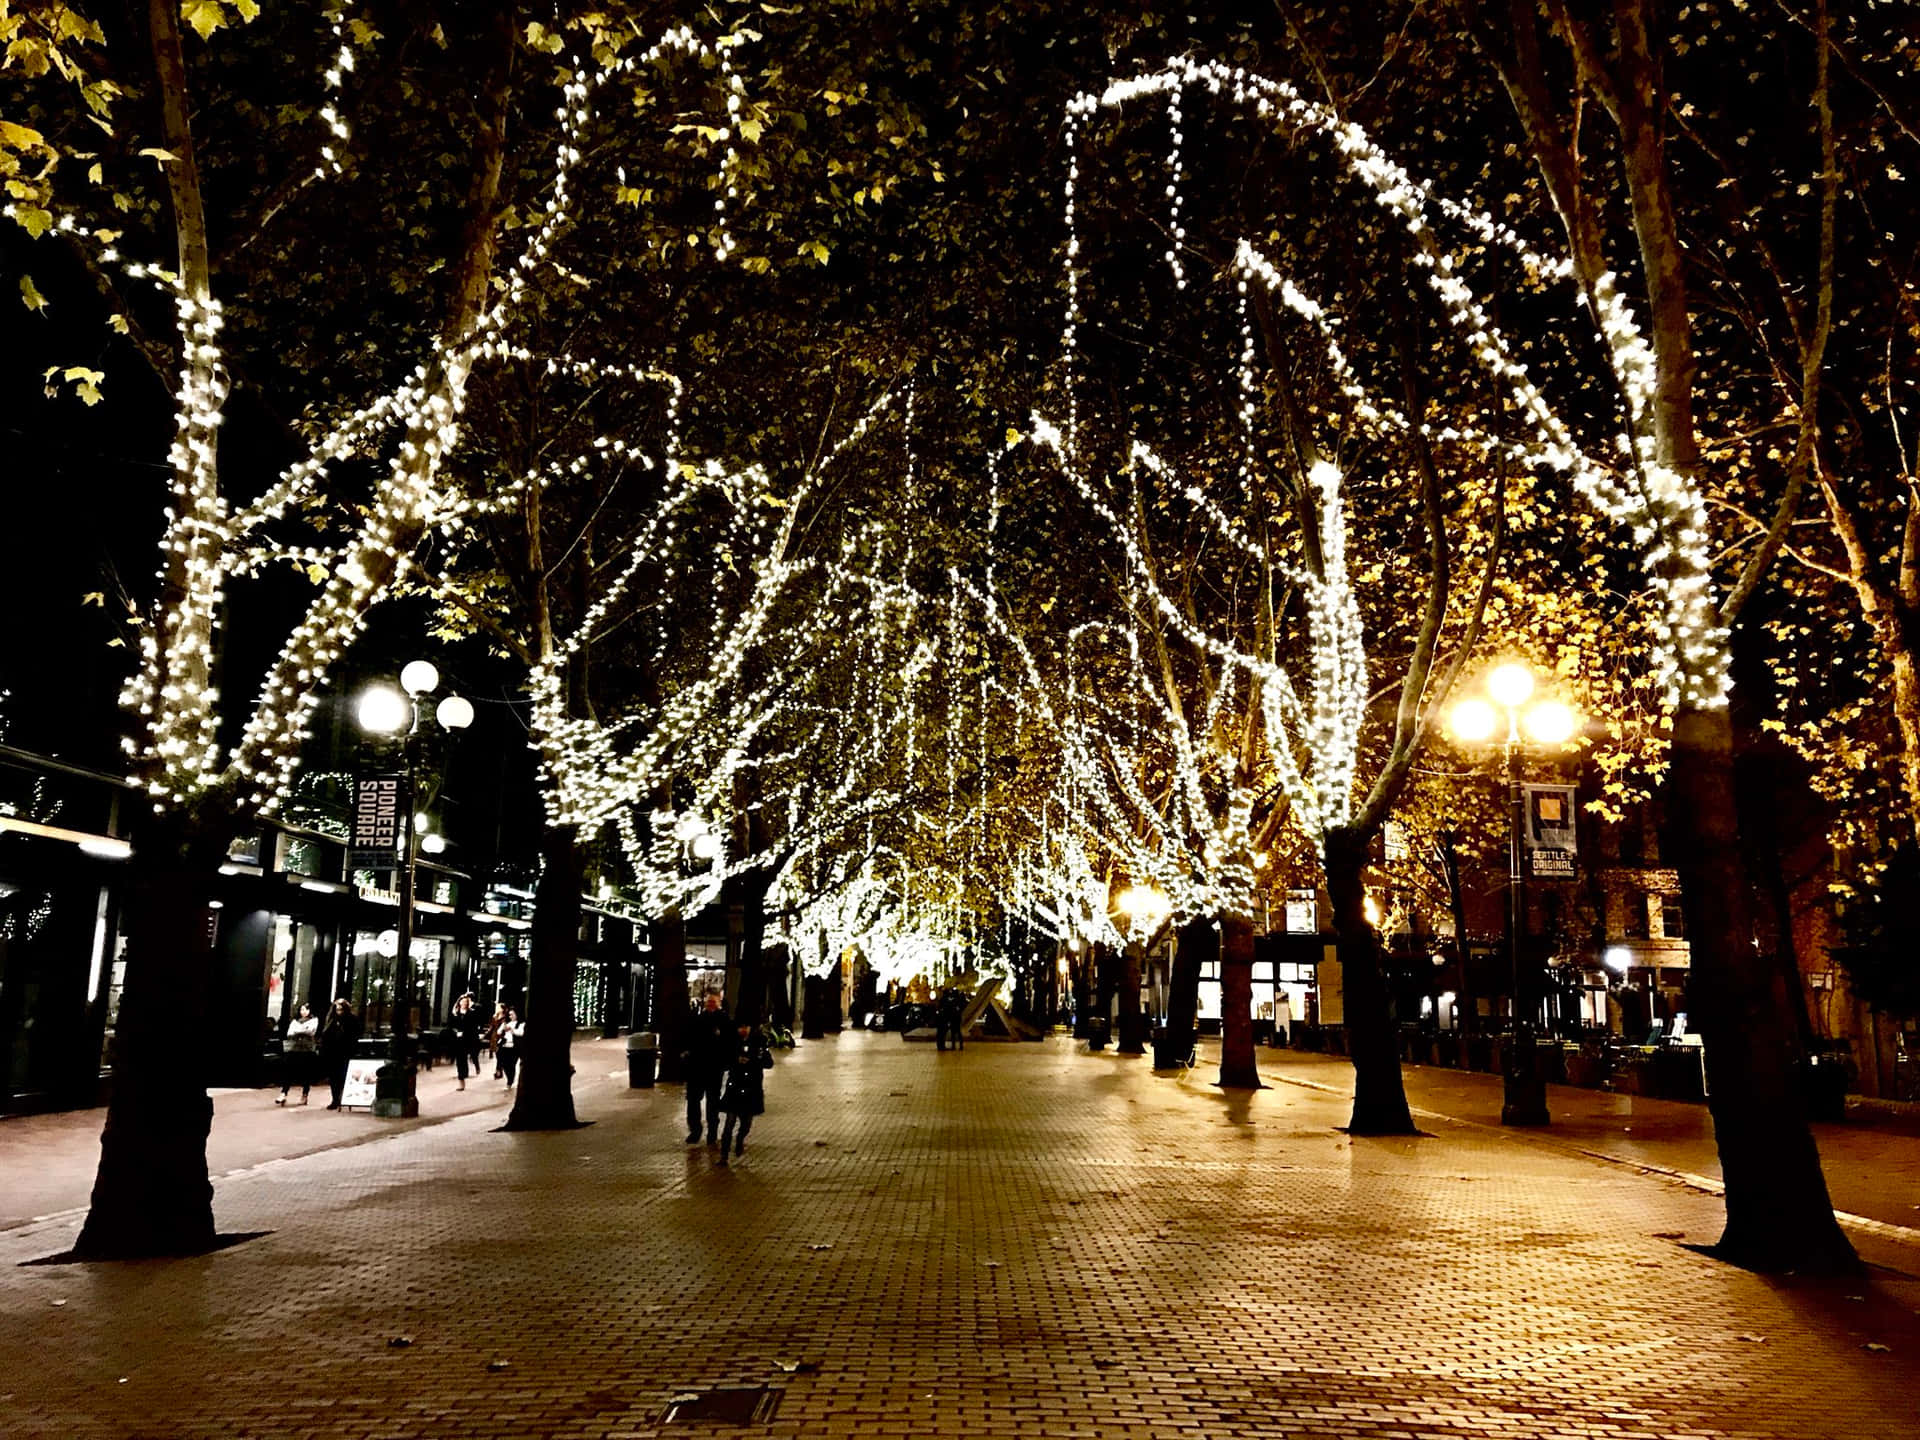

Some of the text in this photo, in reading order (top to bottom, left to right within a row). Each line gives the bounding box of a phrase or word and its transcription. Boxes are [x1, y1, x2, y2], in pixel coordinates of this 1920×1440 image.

[355, 780, 378, 848] SQUARE
[375, 780, 397, 847] PIONEER
[1532, 859, 1575, 870] ORIGINAL
